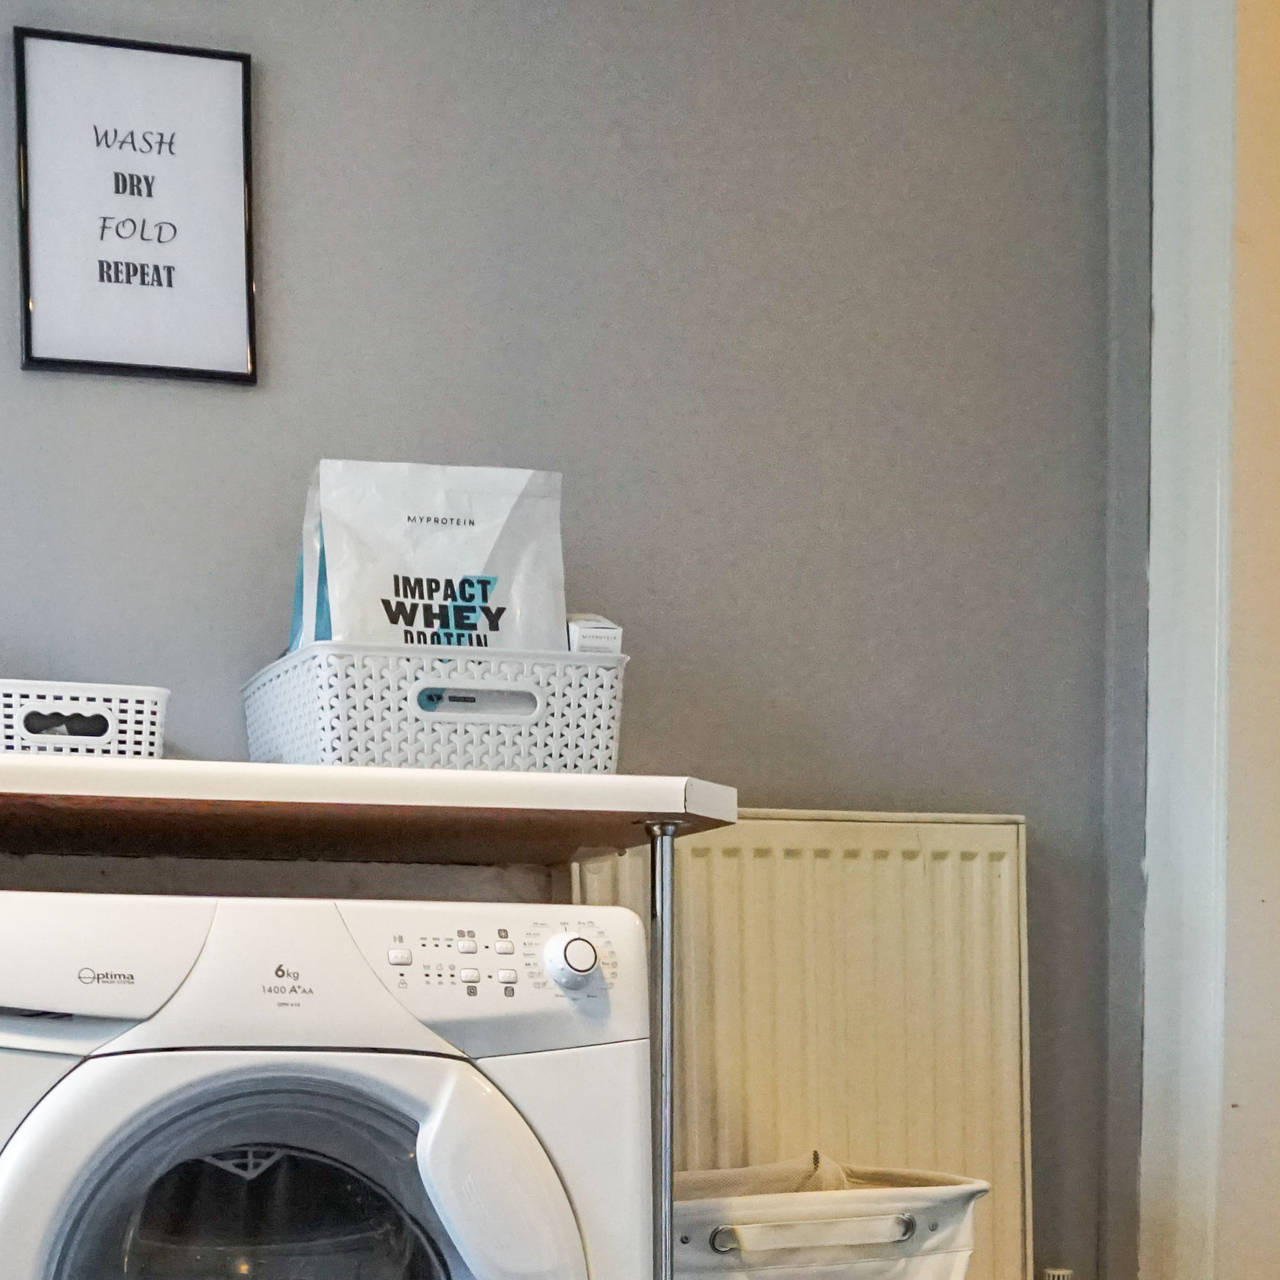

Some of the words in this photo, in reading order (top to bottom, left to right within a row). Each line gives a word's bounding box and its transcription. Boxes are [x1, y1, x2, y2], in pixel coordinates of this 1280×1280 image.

[93, 124, 176, 155] WASH
[113, 171, 155, 198] DRY
[99, 216, 177, 244] FOLD
[98, 259, 175, 288] REPEAT
[407, 515, 475, 527] MYPROTEIN
[393, 574, 491, 603] IMPACT
[380, 598, 507, 632] WHEY
[275, 964, 300, 981] 6kg
[262, 985, 287, 994] 1400
